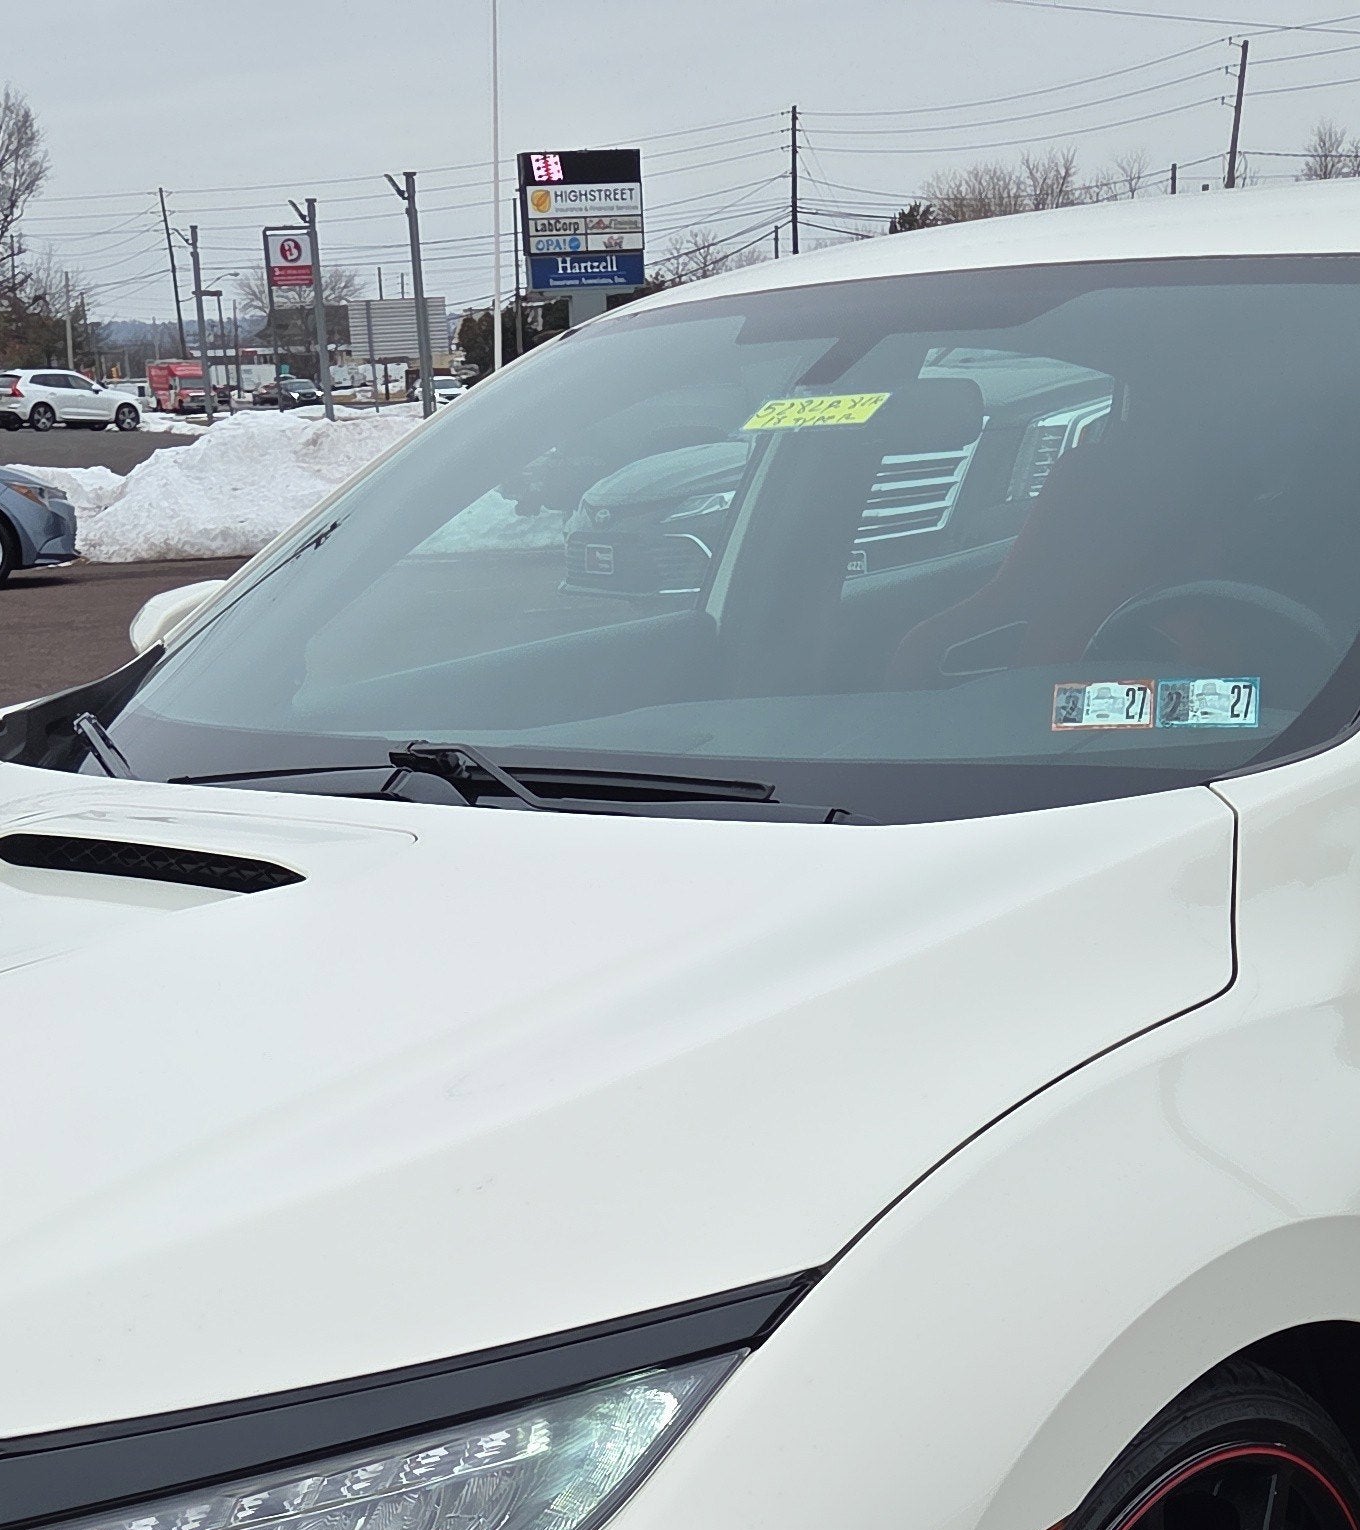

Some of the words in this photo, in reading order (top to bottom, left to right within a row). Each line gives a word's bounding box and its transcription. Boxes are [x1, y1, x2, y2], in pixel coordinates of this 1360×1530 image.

[554, 188, 635, 203] HIGHSTREET
[534, 220, 580, 234] LabCorp
[535, 238, 567, 251] OPA!
[556, 255, 617, 274] Hartzell
[1125, 686, 1148, 722] 27
[1230, 684, 1254, 721] 27
